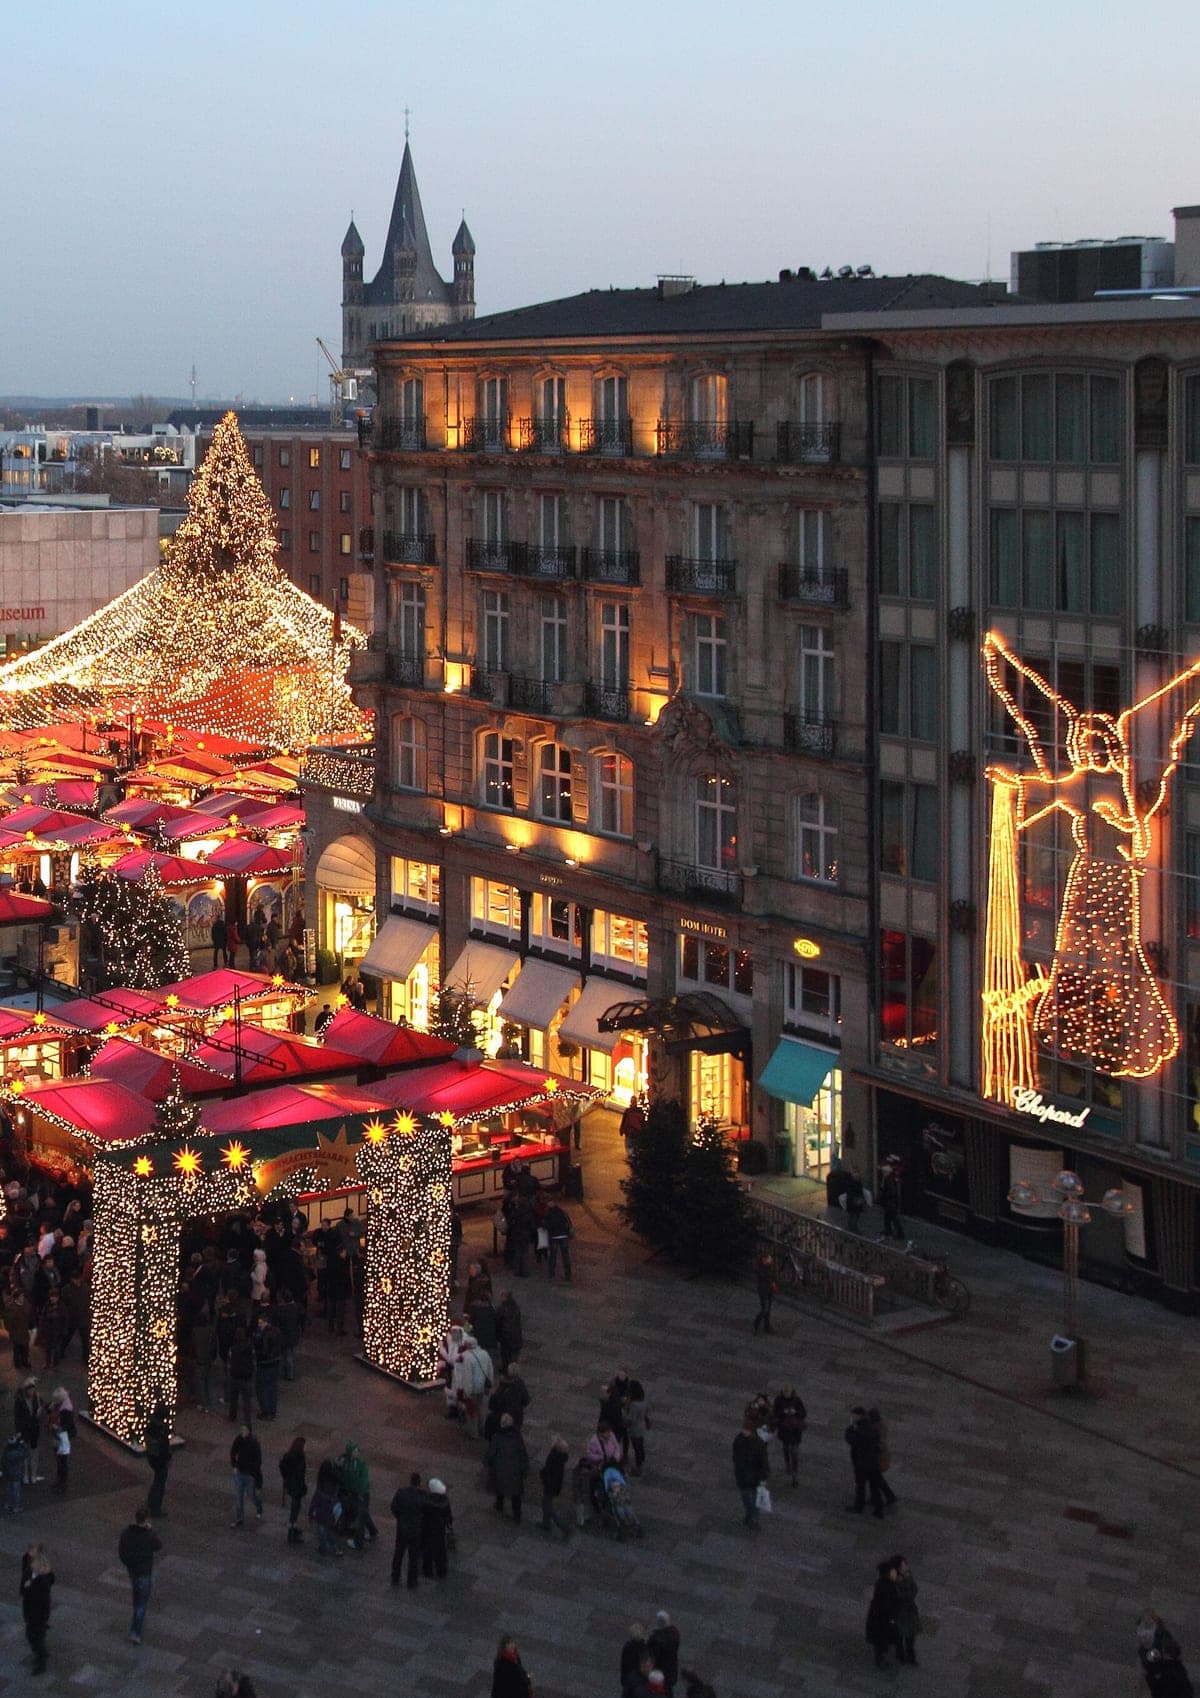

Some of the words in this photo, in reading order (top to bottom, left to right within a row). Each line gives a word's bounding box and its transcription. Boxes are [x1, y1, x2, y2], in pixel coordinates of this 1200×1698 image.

[680, 918, 699, 931] DOM
[701, 923, 727, 937] HOTEL
[1011, 1086, 1091, 1128] Chopard
